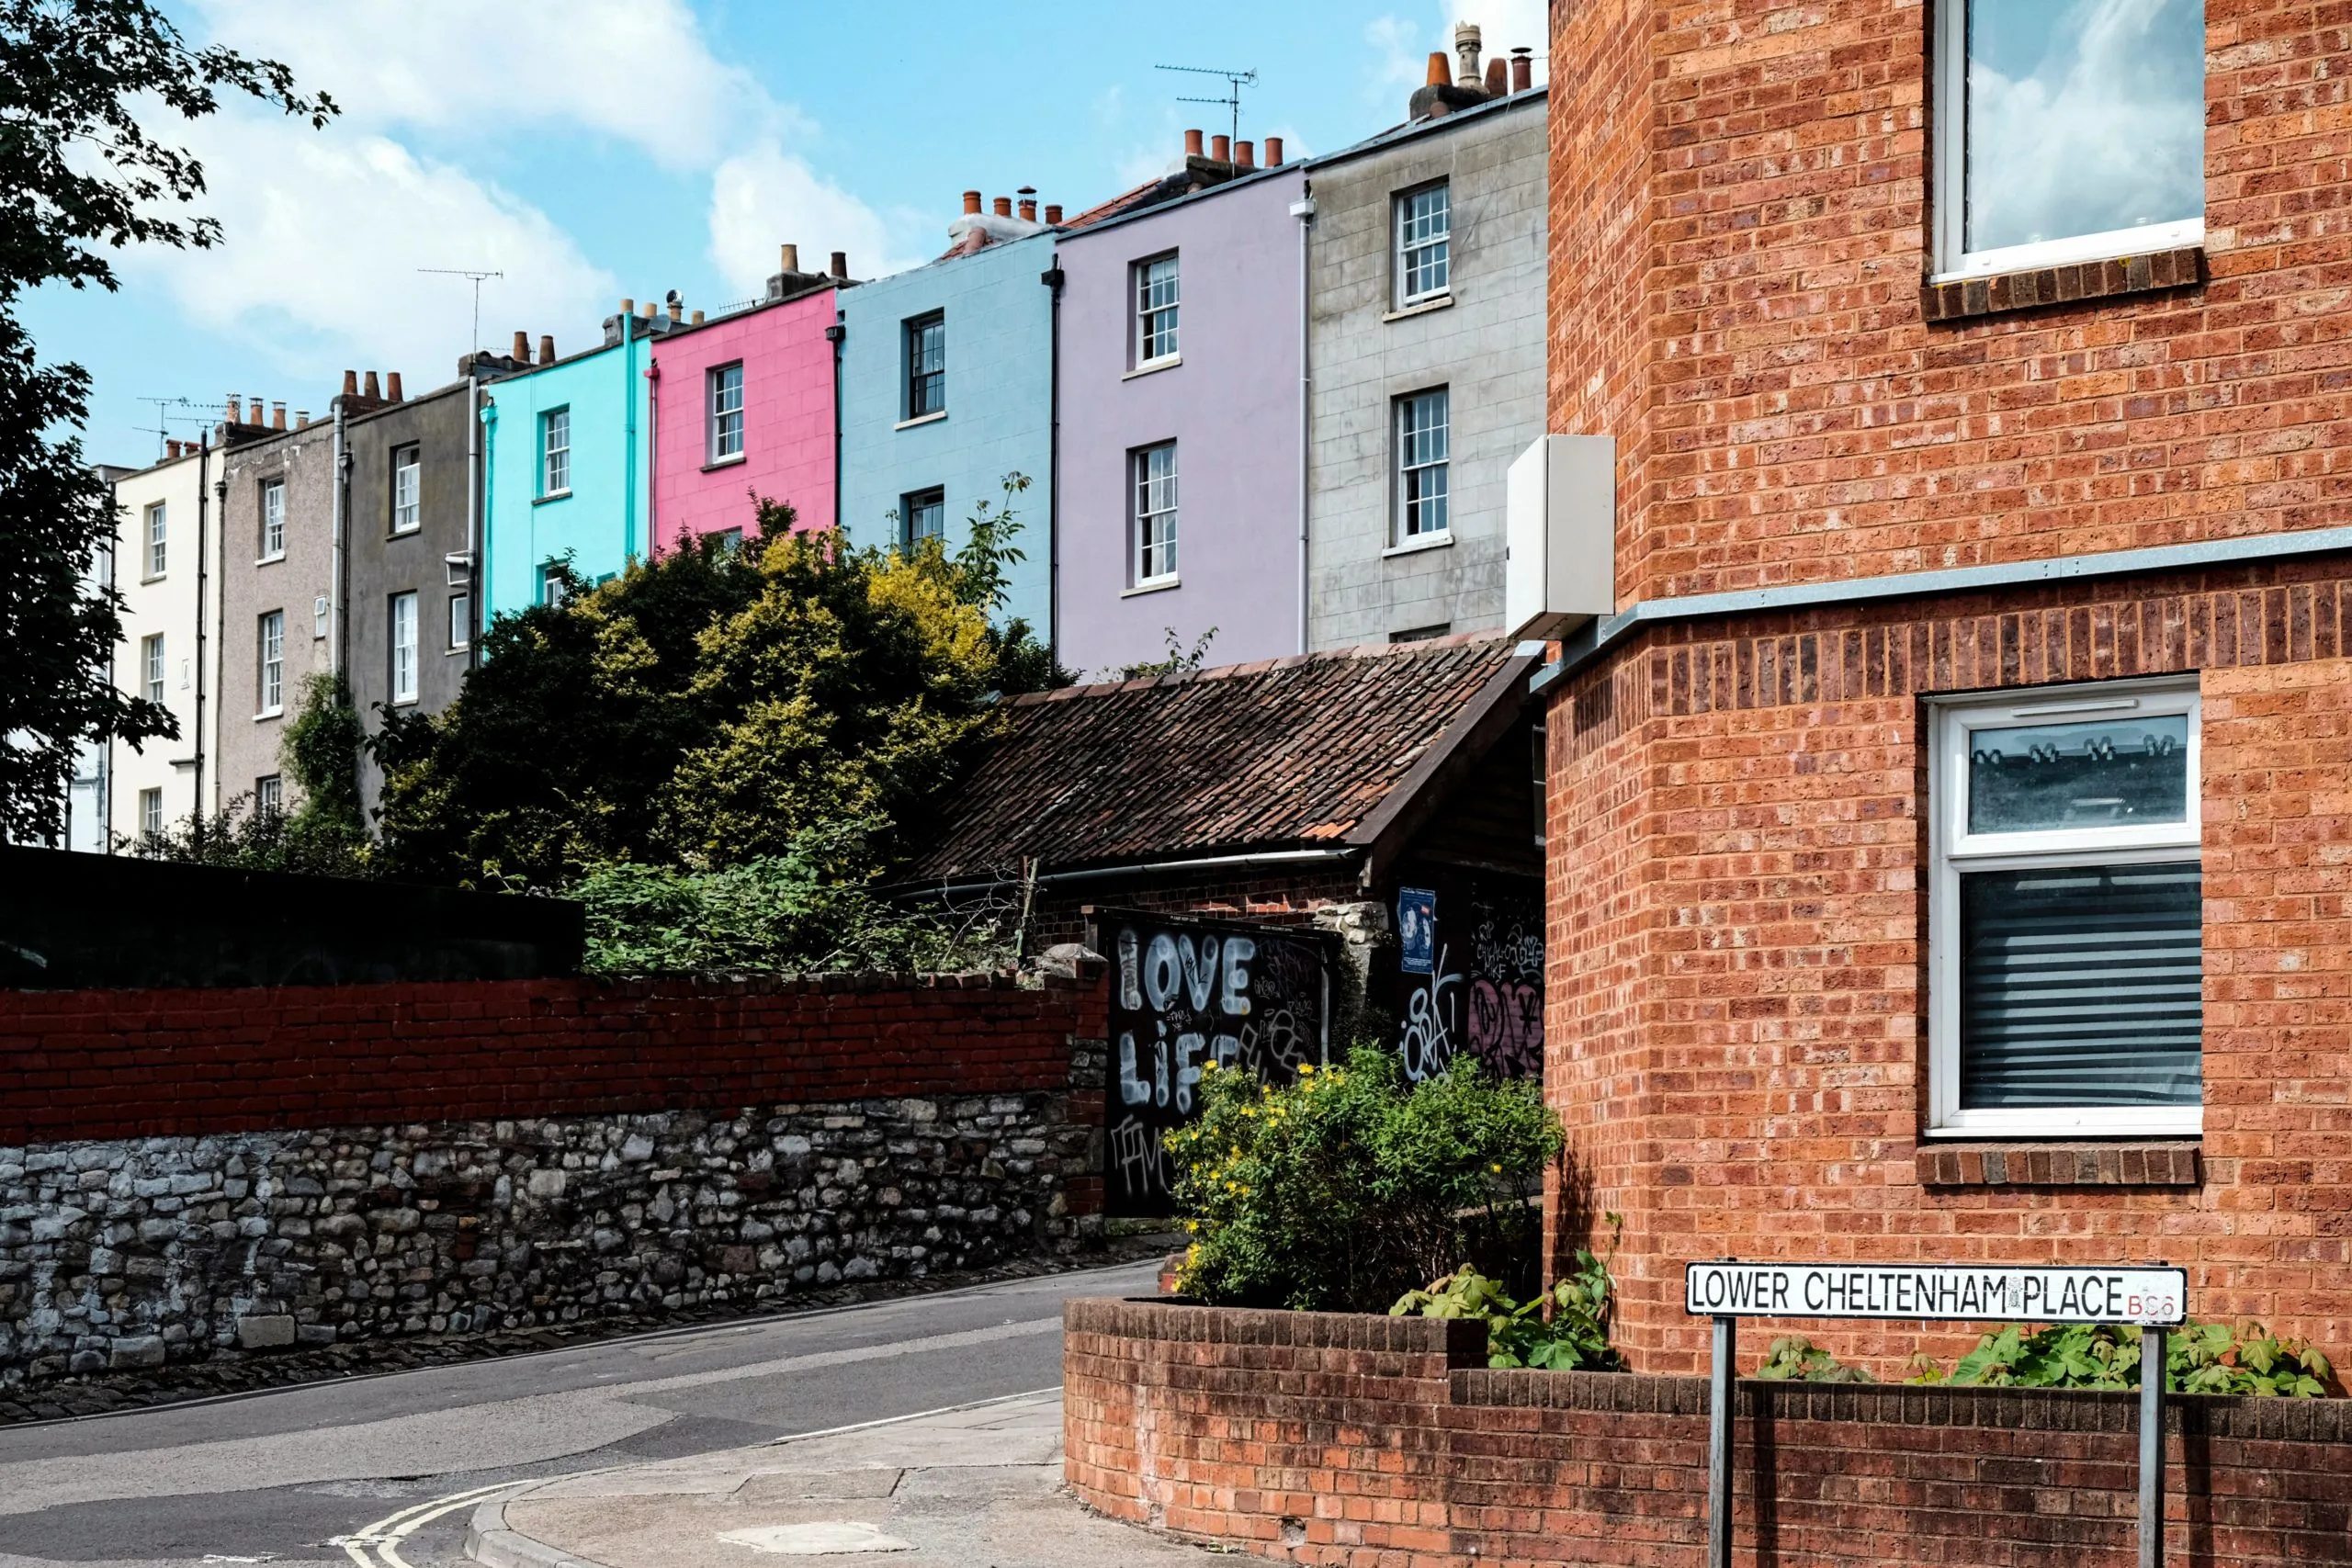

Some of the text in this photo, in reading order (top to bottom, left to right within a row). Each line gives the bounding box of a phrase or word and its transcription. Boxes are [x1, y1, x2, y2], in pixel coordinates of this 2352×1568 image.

[1117, 928, 1256, 1015] LOVE
[1692, 1269, 2175, 1317] LOWER CHELTENHAM PLACE BS6
